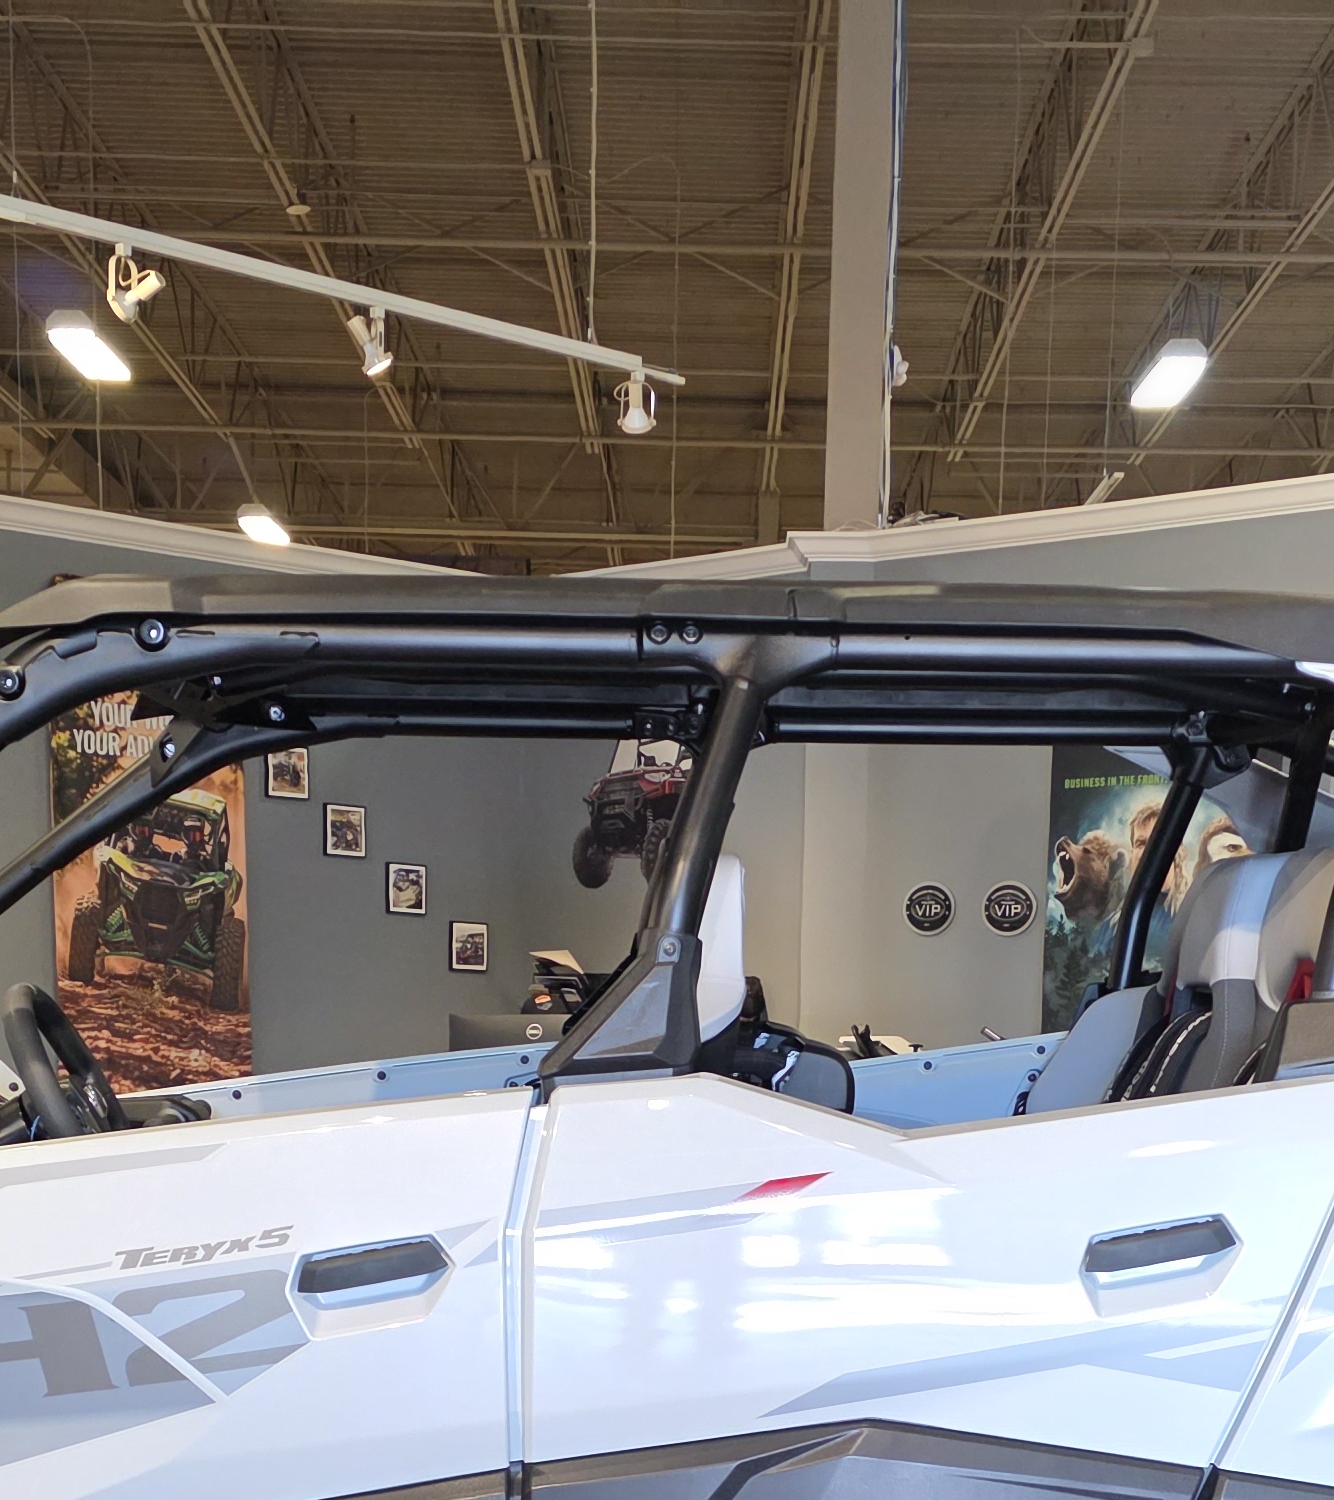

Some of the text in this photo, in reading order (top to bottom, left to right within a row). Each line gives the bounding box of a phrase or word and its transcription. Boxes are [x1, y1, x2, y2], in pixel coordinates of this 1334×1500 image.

[73, 728, 121, 756] YOUR
[1064, 777, 1105, 789] BUSINESS
[1107, 775, 1117, 787] IN
[1118, 775, 1135, 786] THE
[915, 904, 941, 917] VIP
[994, 904, 1022, 917] VIP
